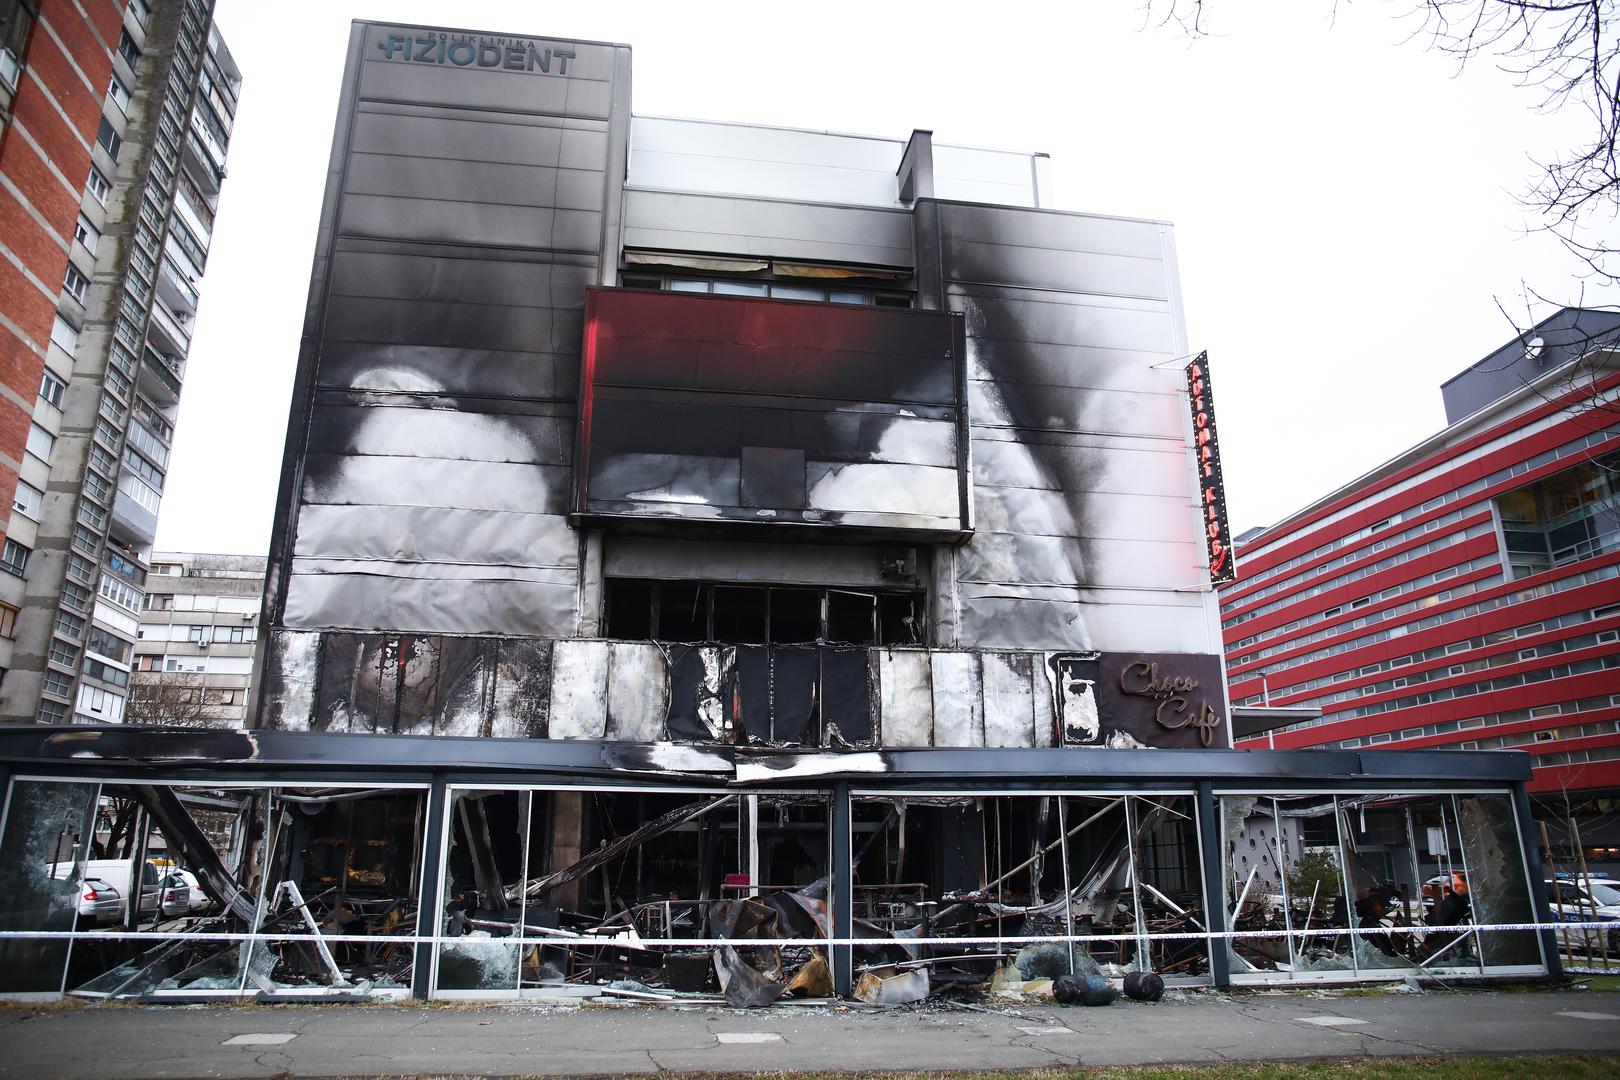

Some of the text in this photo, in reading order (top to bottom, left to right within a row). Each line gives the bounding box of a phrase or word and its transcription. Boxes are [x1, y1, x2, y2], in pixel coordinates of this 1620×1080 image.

[378, 35, 576, 75] FIZIODENT
[428, 32, 535, 48] POLIKLINIKA
[1192, 364, 1222, 555] AUTOMAT KLUB
[1120, 660, 1200, 697] Choco
